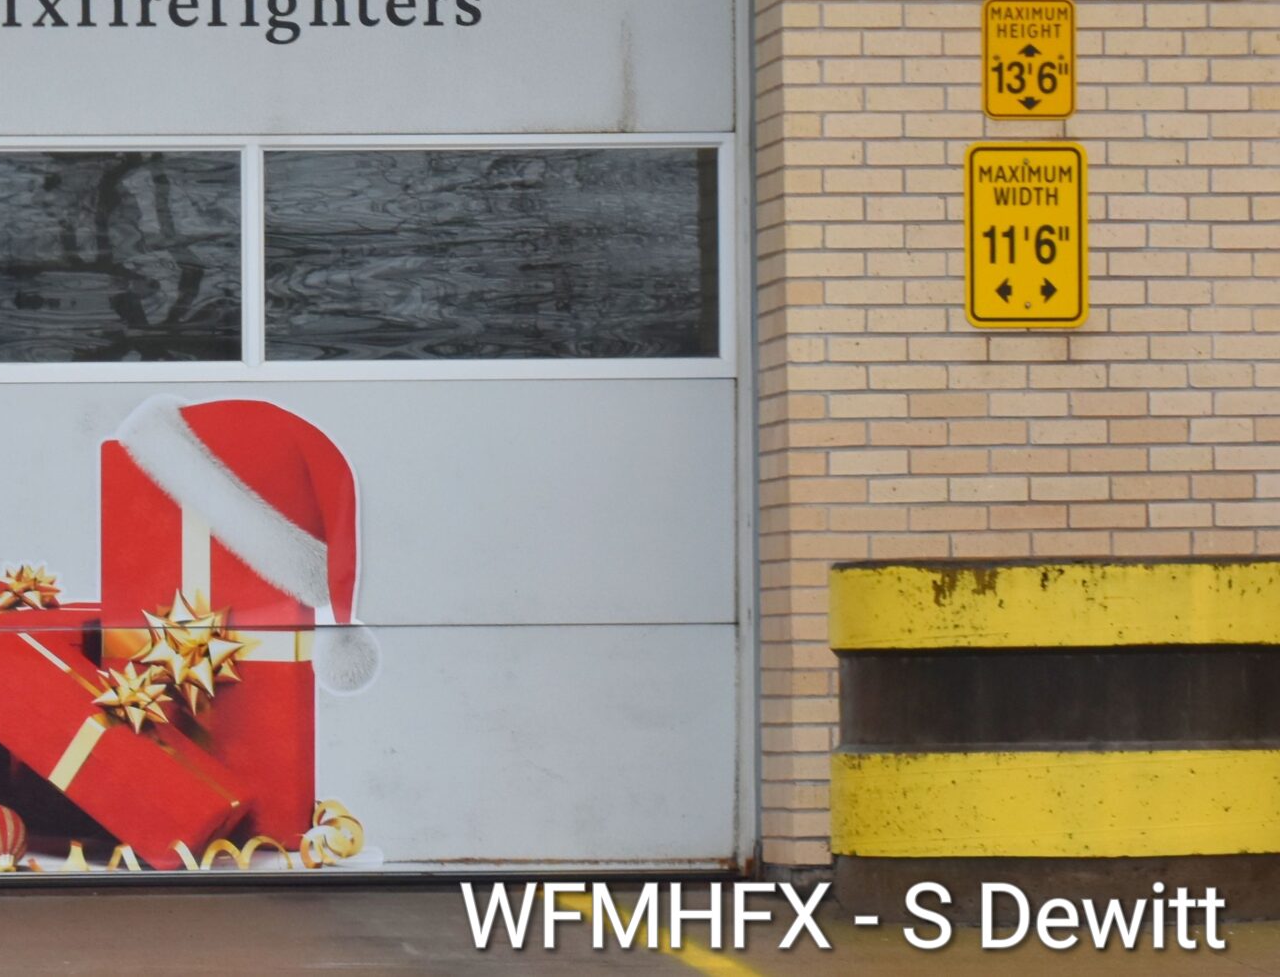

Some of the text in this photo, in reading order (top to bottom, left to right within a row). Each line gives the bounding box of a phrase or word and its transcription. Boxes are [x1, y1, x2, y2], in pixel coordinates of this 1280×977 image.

[991, 7, 1069, 22] MAXIMUM
[996, 23, 1062, 39] HEIGHT
[978, 166, 1073, 183] MAXIMUM
[993, 187, 1059, 206] WIDTH
